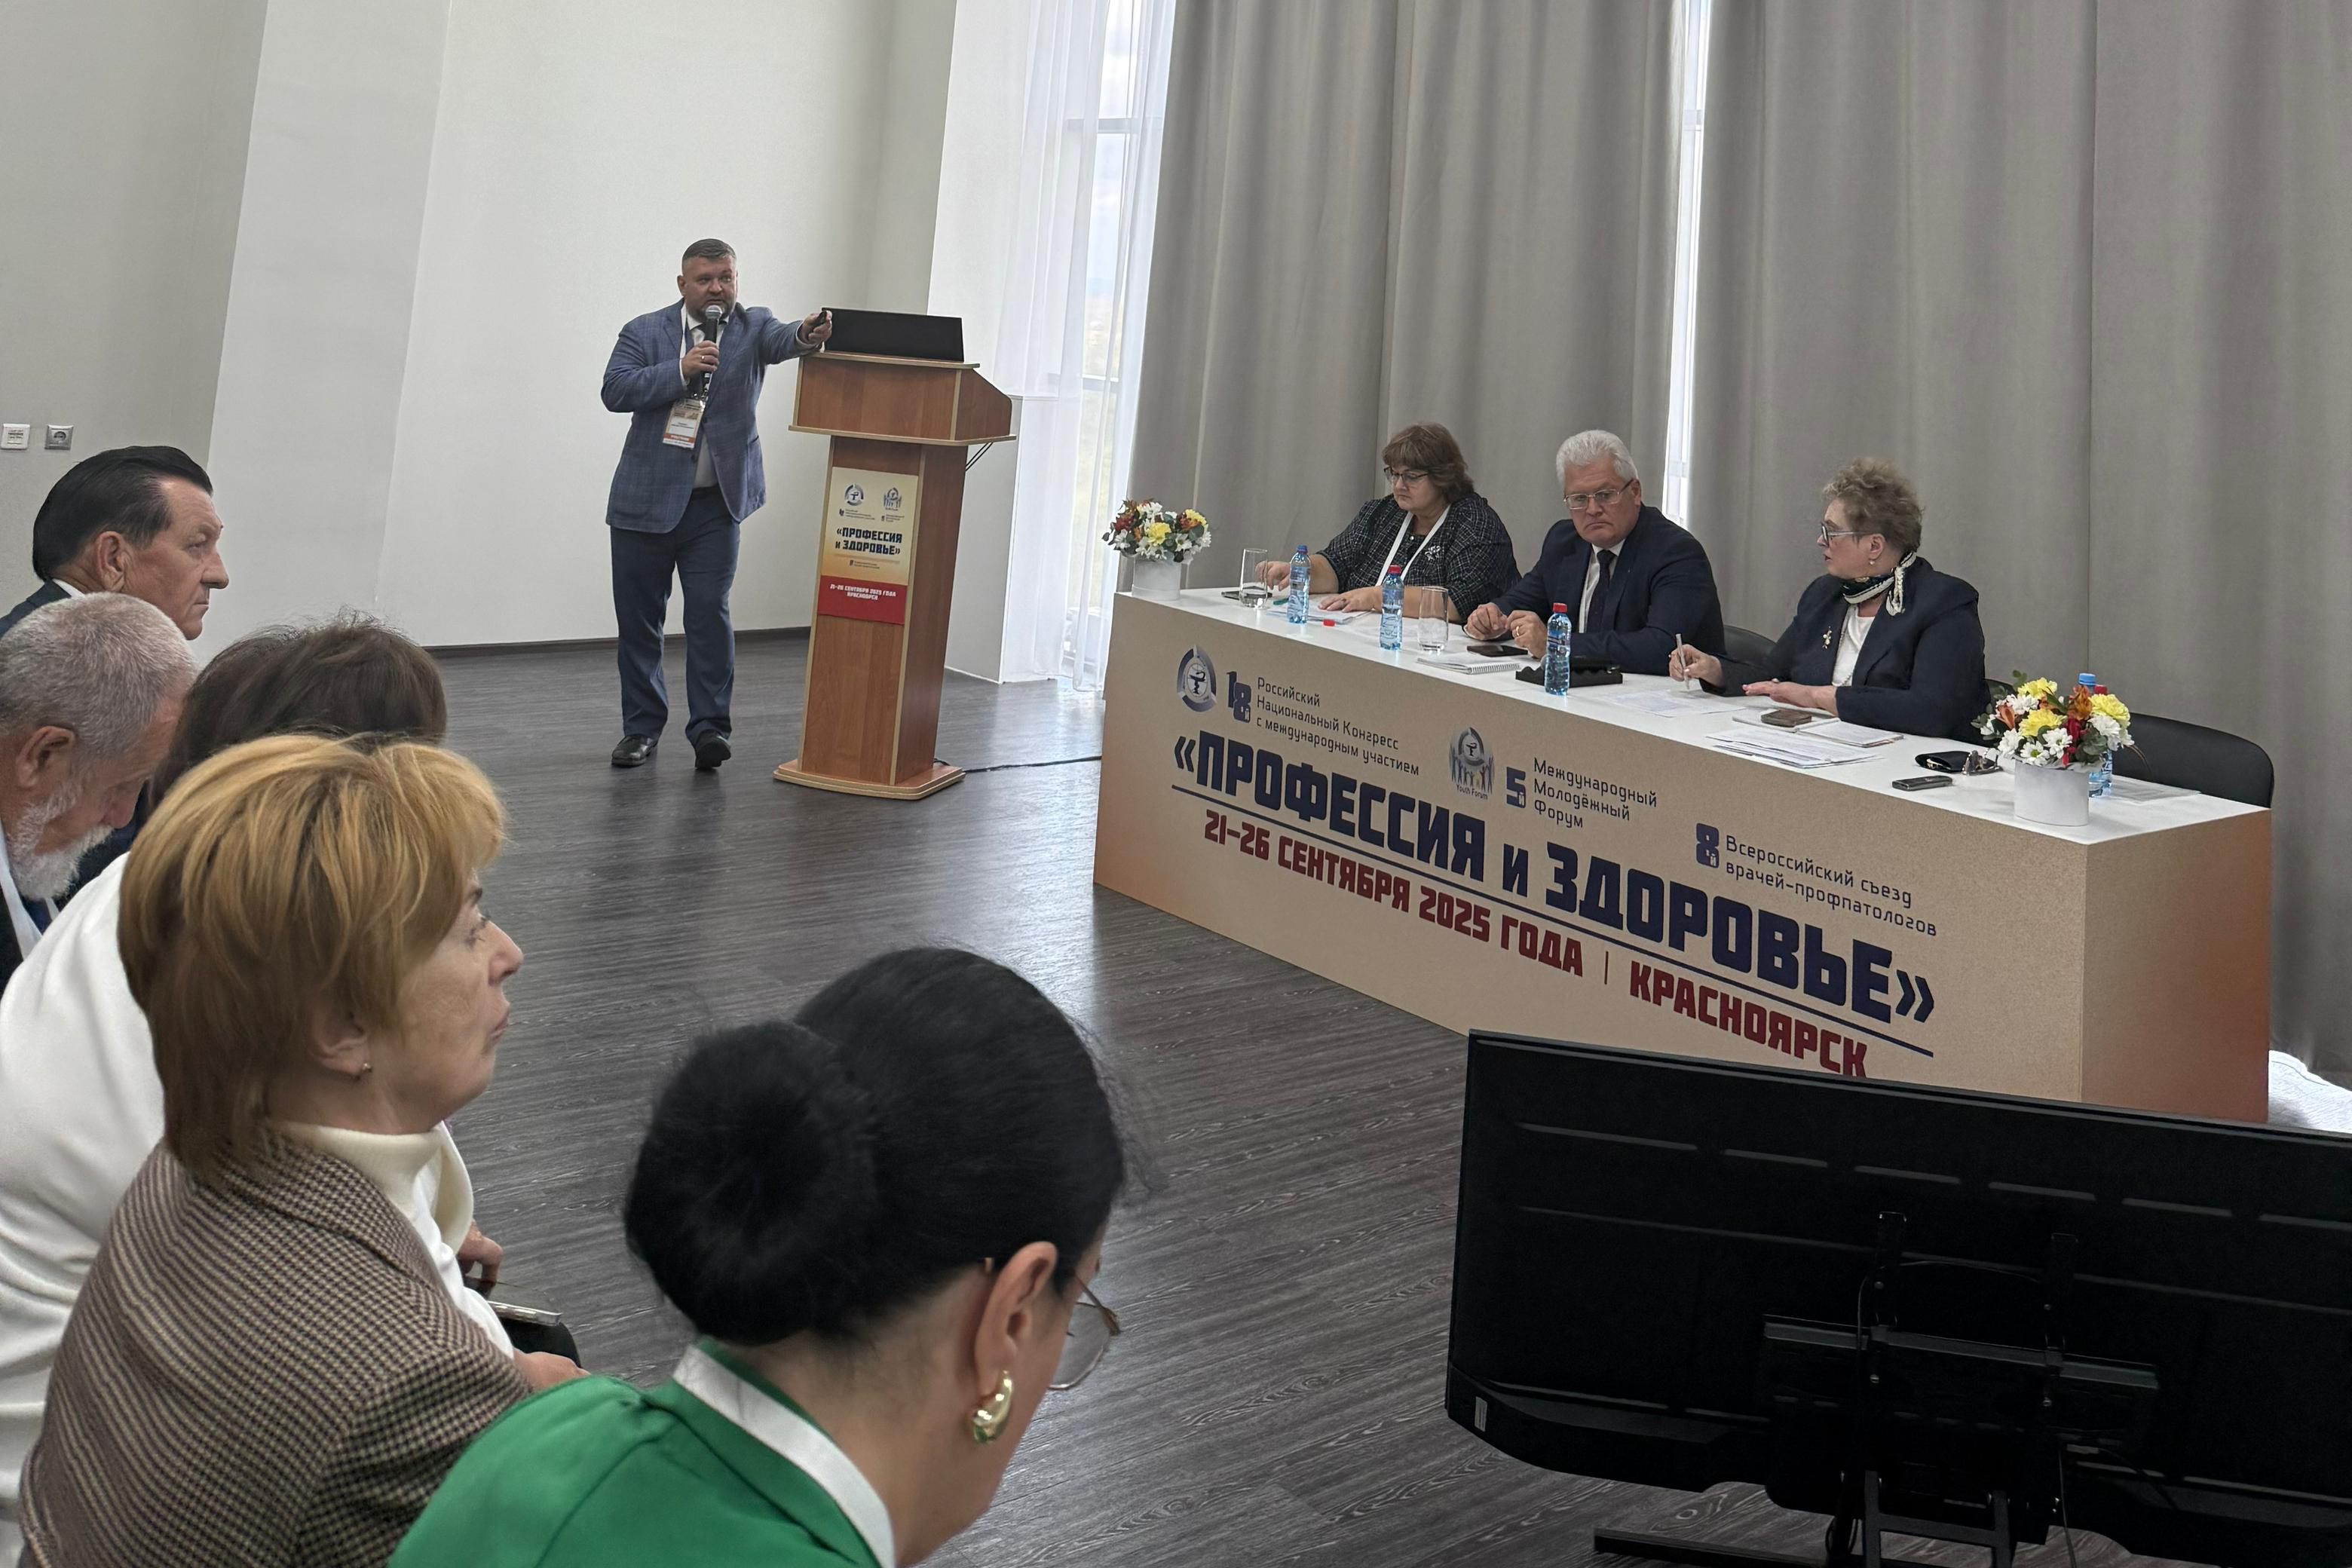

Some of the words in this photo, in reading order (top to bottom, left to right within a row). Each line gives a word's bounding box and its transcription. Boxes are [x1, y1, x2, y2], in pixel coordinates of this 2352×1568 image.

[837, 527, 902, 543] «ПРОФЕССИЯ
[843, 540, 901, 555] ЗДОРОВЬЕ»
[1257, 677, 1321, 707] Российский
[1257, 695, 1340, 731] Национальный
[1343, 721, 1399, 750] Конгресс
[1257, 717, 1262, 727] с
[1265, 719, 1358, 757] международным
[1363, 749, 1419, 776] участием
[1456, 785, 1470, 795] Youth
[1471, 788, 1488, 800] Forum
[1534, 757, 1657, 807] Международный
[1534, 778, 1630, 821] Молодёжный
[1534, 799, 1583, 828] Форум
[1173, 730, 1485, 883] «ПРОФЕССИЯ
[1502, 843, 1528, 897] и
[1545, 841, 1934, 1024] ЗДОРОВЬЕ»
[1726, 835, 1854, 887] Всероссийский
[1861, 879, 1912, 908] съезд
[1726, 862, 1937, 936] врачей-профпатологов
[1278, 835, 1410, 912] СЕНТЯБРЯ
[1419, 885, 1490, 942] 2025
[1501, 913, 1583, 977] ГОДА
[1630, 960, 1867, 1079] КРАСНОЯРСК
